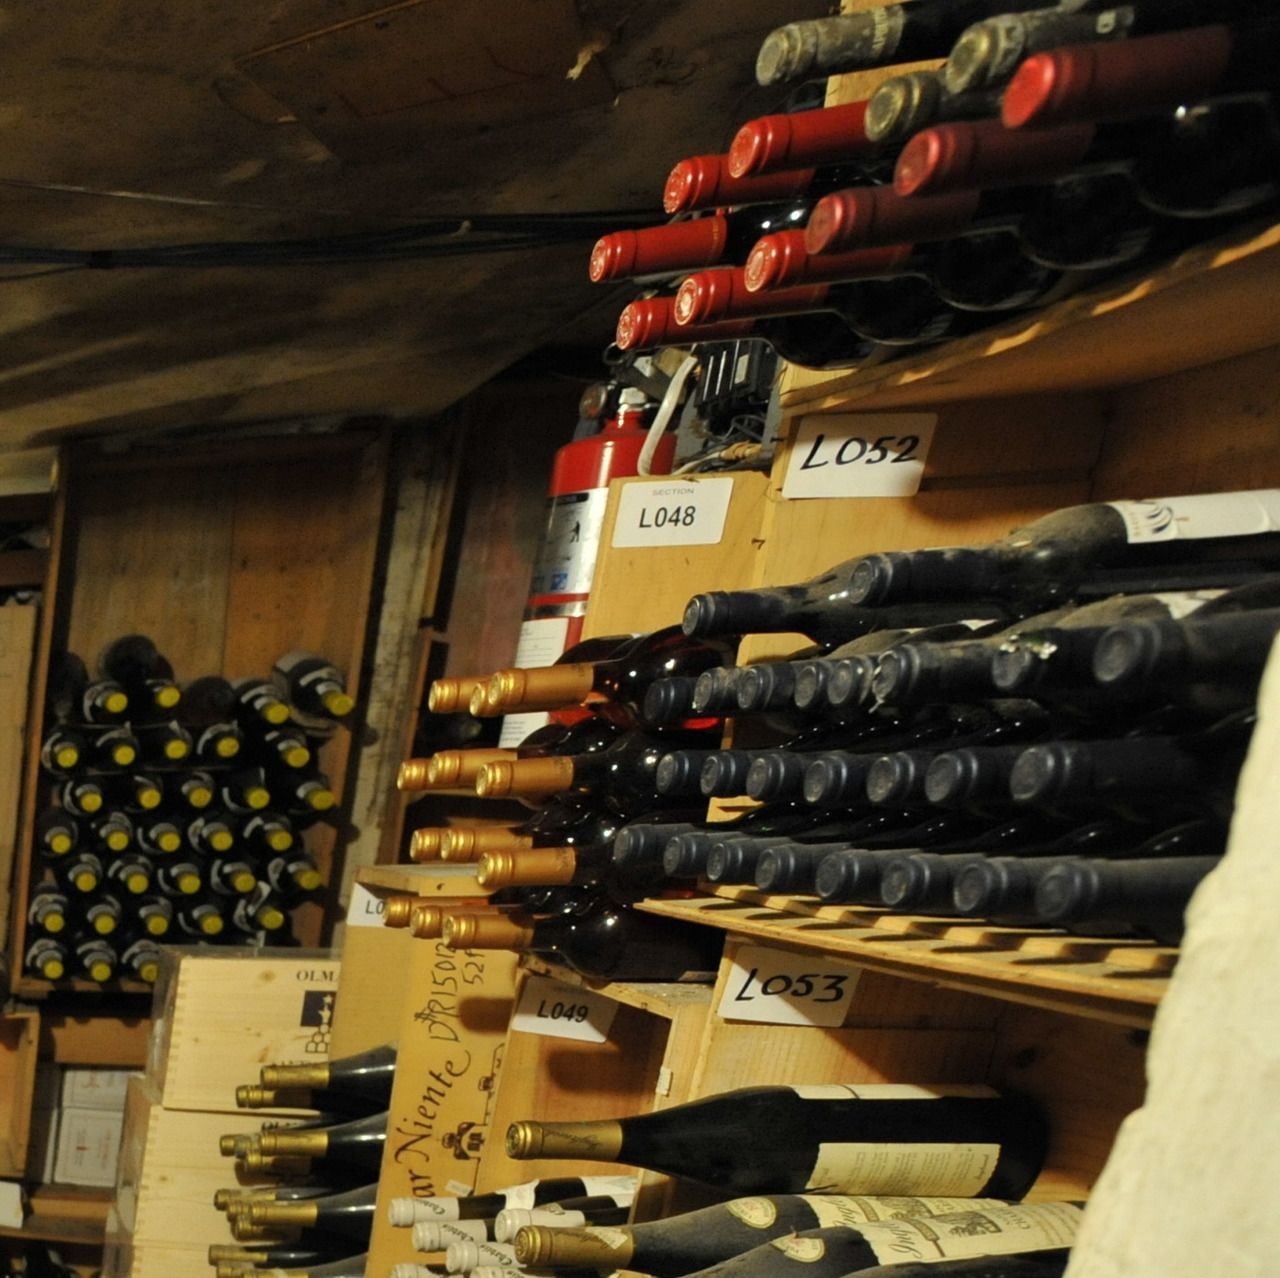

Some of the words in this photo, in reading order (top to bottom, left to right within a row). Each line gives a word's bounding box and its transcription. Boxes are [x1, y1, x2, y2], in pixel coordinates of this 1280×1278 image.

[651, 487, 695, 497] SECTION
[638, 505, 697, 529] L048
[296, 969, 338, 982] OLM
[535, 999, 590, 1024] L049
[393, 1049, 472, 1165] Niente
[407, 1168, 437, 1199] ar
